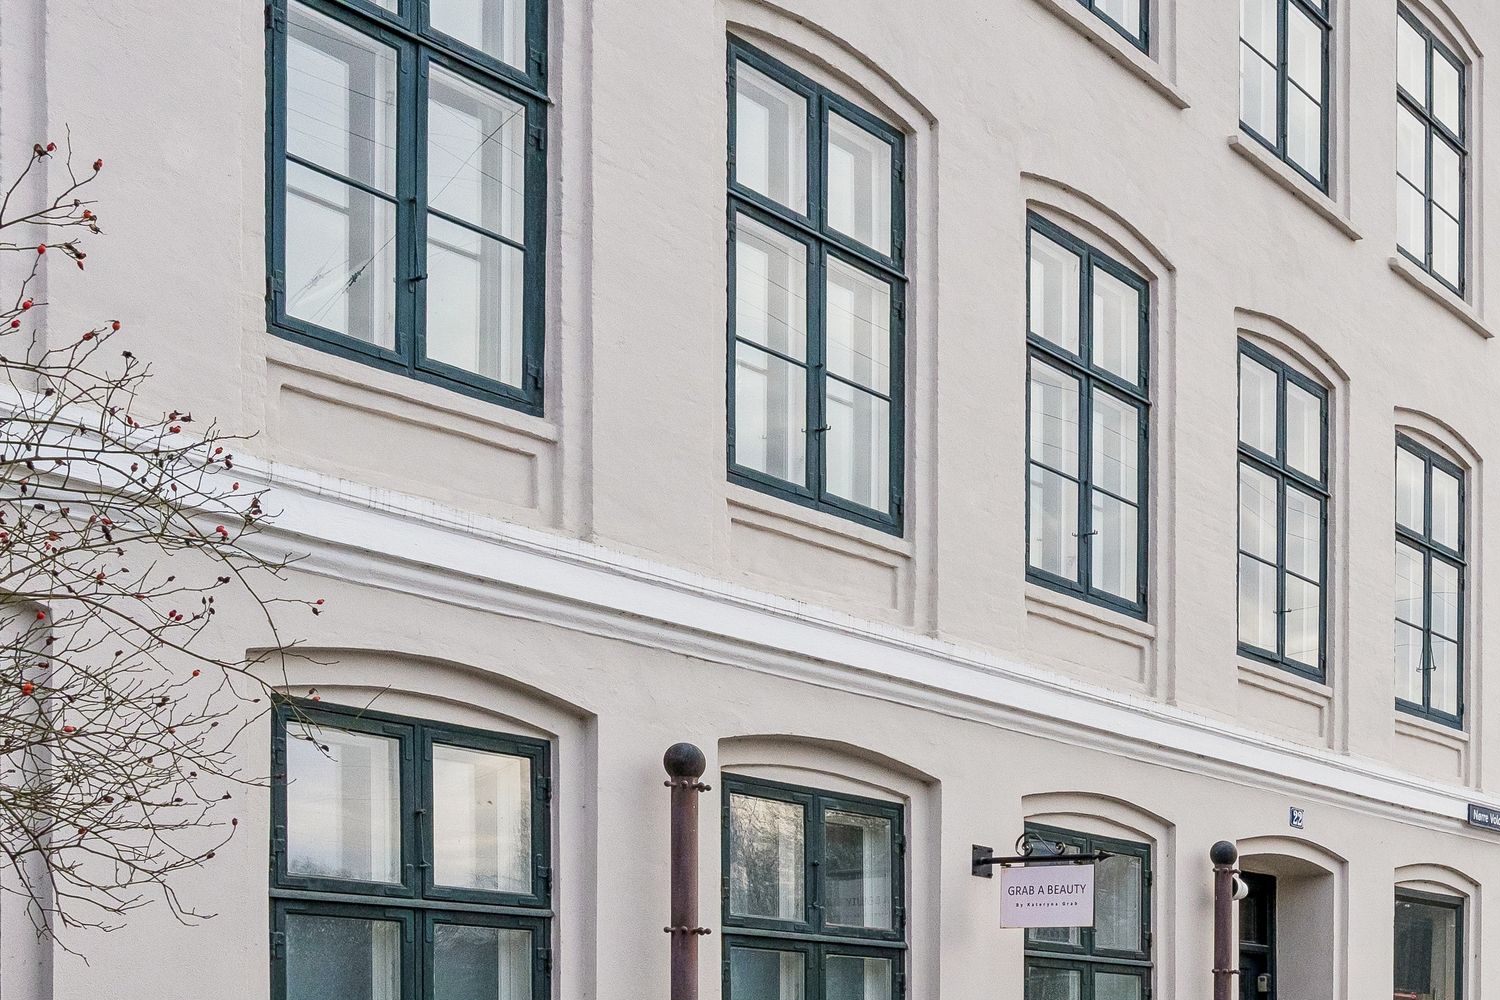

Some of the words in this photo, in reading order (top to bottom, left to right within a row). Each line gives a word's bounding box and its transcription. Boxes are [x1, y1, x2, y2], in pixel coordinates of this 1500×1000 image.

[1293, 810, 1302, 825] 22
[1473, 809, 1488, 822] Nørre
[1008, 886, 1034, 895] GRAB
[1038, 885, 1044, 894] A
[1047, 884, 1086, 894] BEAUTY
